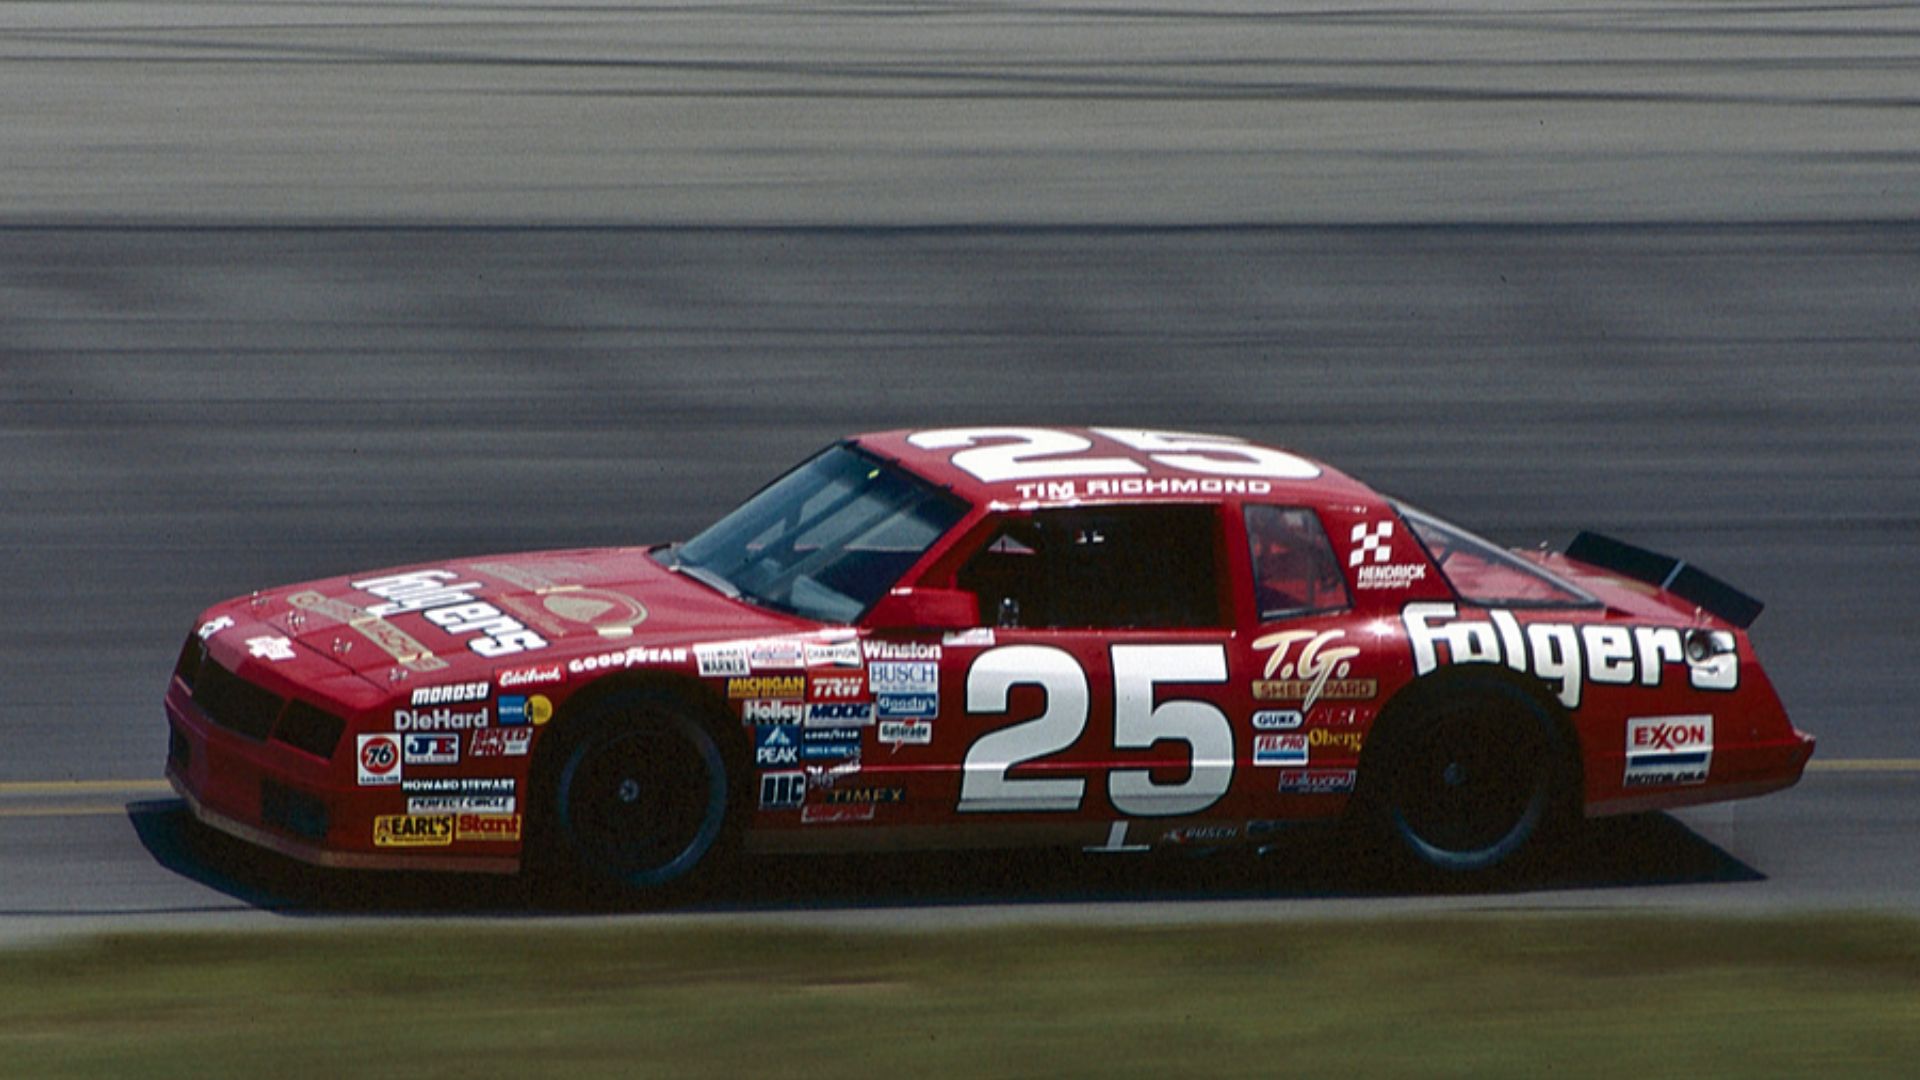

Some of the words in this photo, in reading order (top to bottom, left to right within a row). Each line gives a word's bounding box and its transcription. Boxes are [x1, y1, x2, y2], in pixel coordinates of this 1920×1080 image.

[905, 427, 1322, 483] 25
[1016, 482, 1074, 499] TIM
[1087, 479, 1271, 496] RICHMOND
[1358, 563, 1427, 581] HENDRICK
[568, 646, 688, 673] GOODYEAR
[863, 640, 942, 660] Winston
[1402, 602, 1739, 709] Folgers
[871, 662, 935, 683] BUSCH
[728, 677, 804, 691] MICHIGAN
[812, 677, 864, 698] TRW
[394, 708, 489, 731] DieHard
[746, 700, 802, 722] Holley
[808, 703, 870, 720] MOOG
[881, 724, 929, 739] Gatorade
[957, 644, 1235, 817] 25
[1309, 728, 1362, 751] Oberg
[1634, 723, 1705, 750] EXXON
[366, 743, 393, 766] 76
[408, 737, 457, 755] JE
[757, 747, 798, 763] PEAK
[402, 779, 459, 791] HOWARD
[461, 778, 515, 791] STEWART
[832, 788, 903, 801] TIMEX
[392, 816, 451, 834] EARL'S
